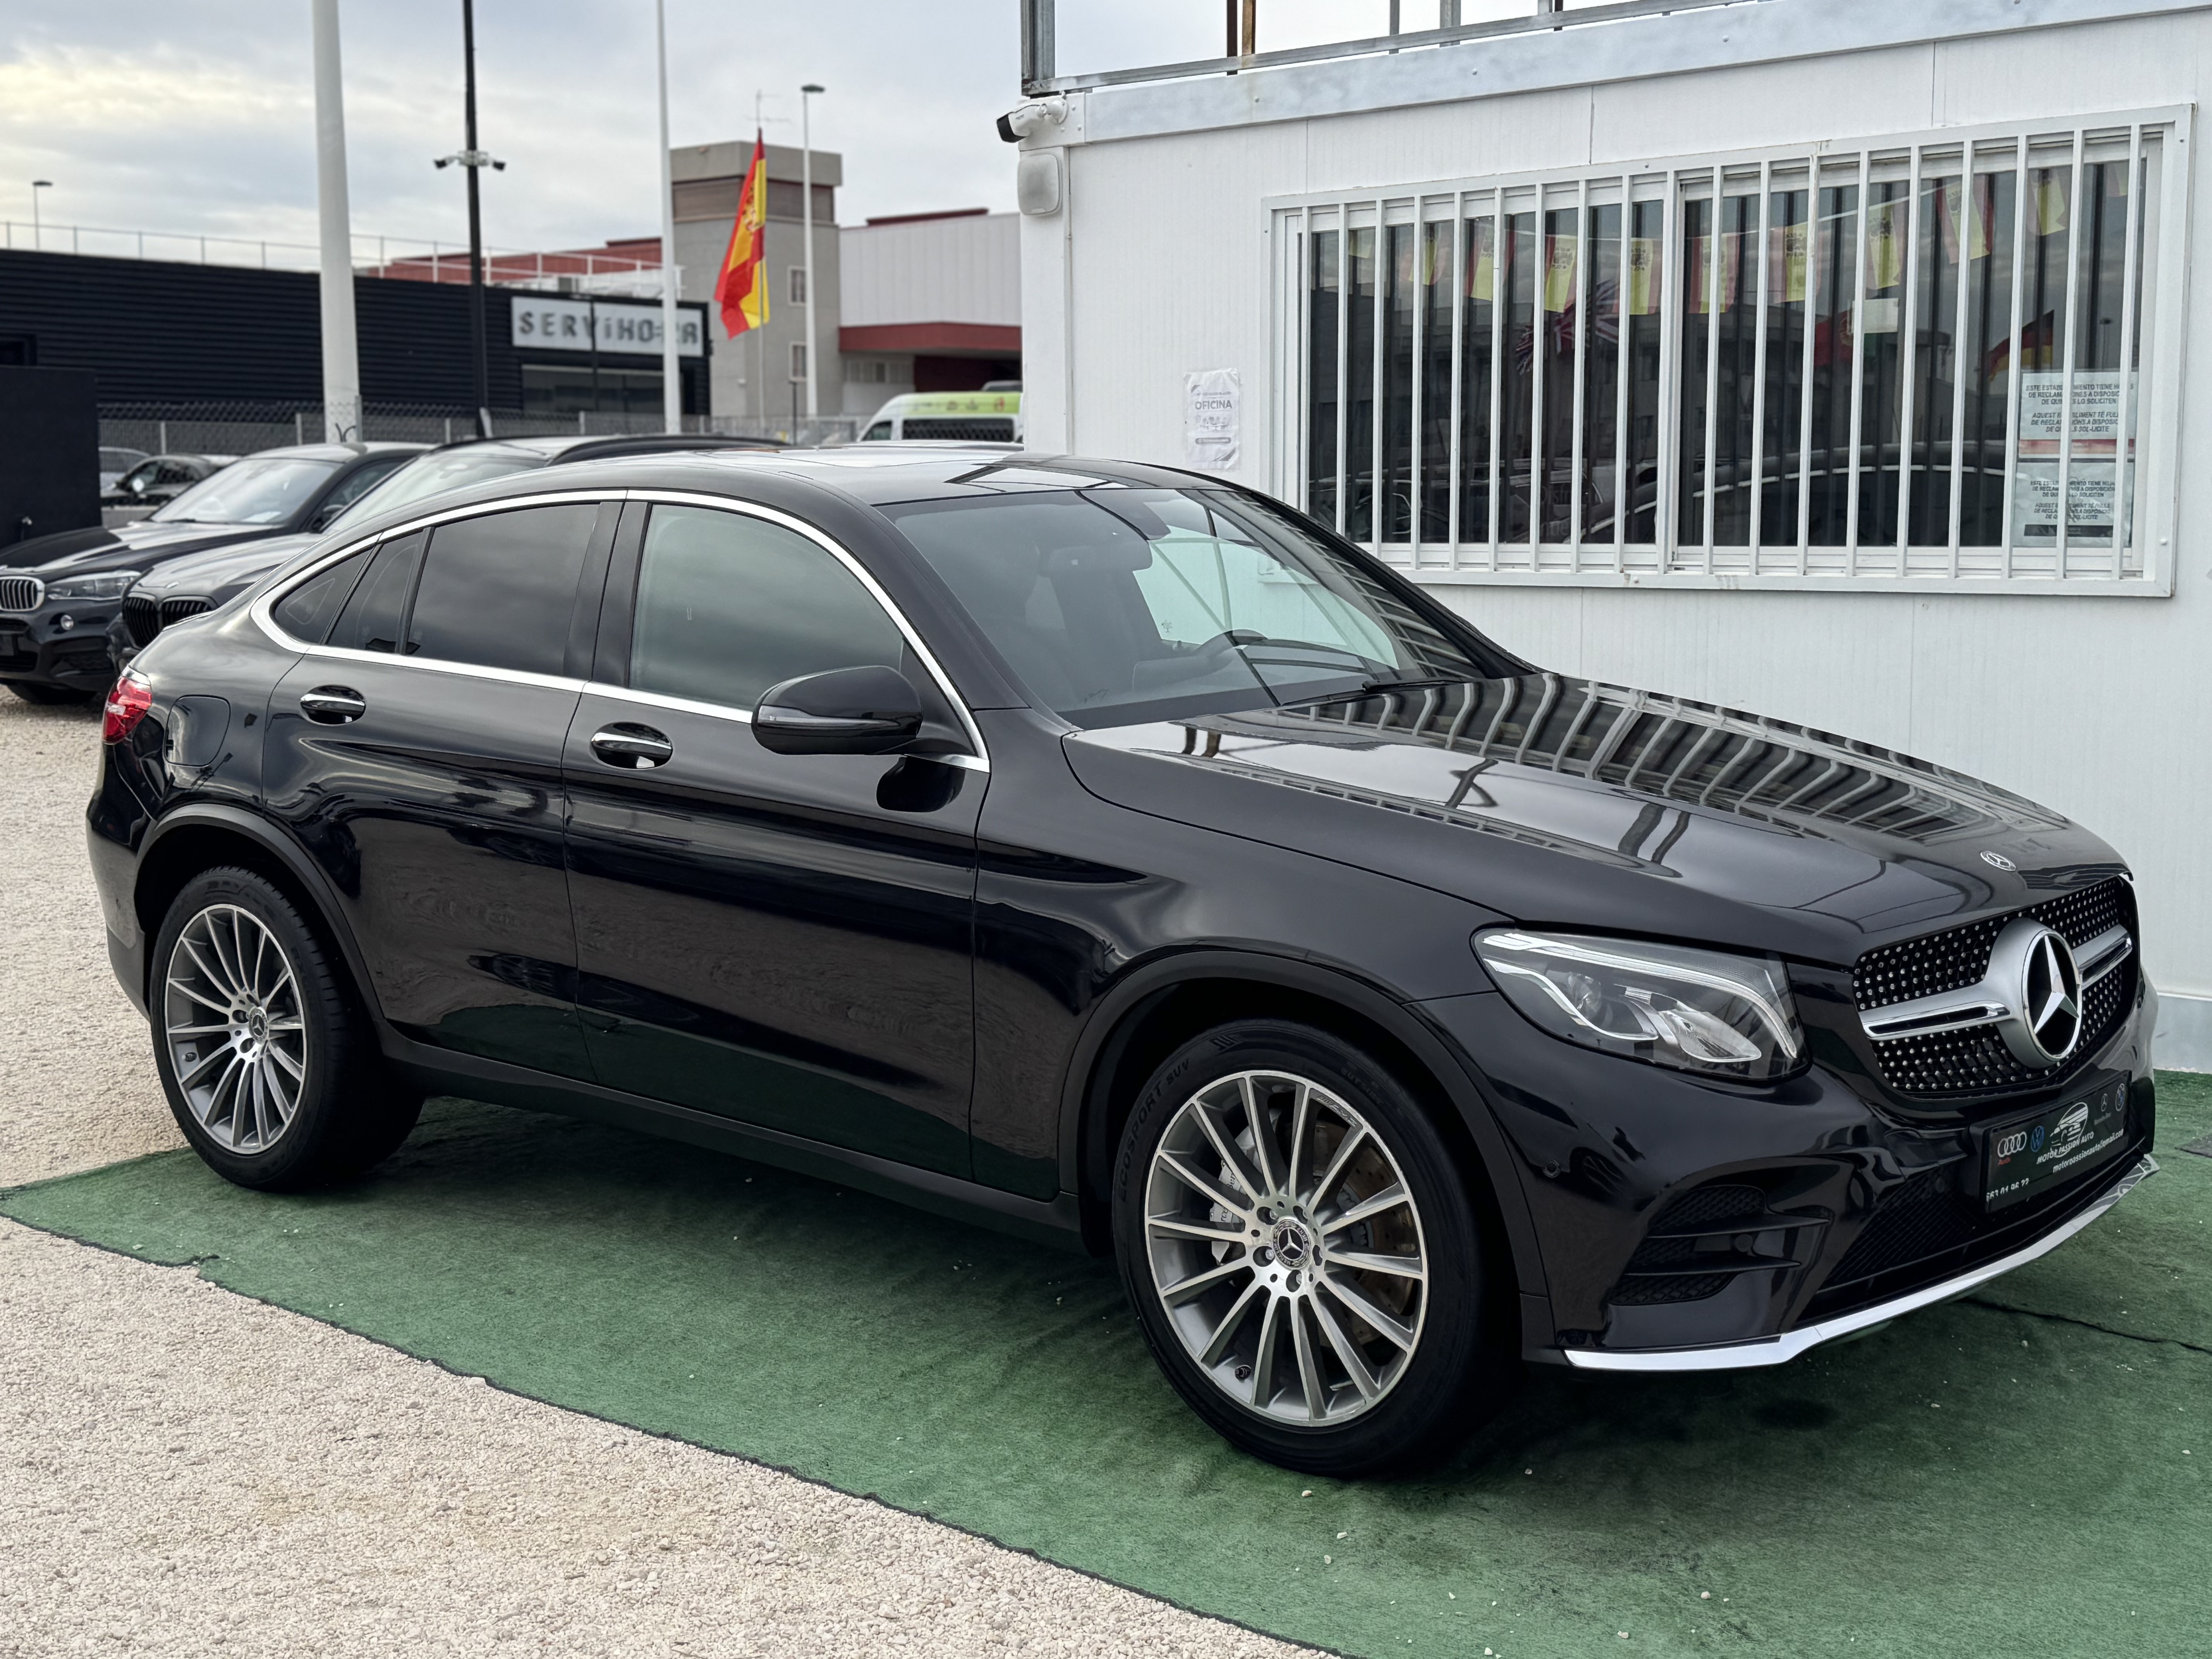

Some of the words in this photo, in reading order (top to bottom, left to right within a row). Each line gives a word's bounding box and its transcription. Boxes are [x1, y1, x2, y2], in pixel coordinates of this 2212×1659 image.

[1195, 400, 1232, 410] OFICINA
[1167, 1058, 1189, 1085] SUV
[2081, 1131, 2094, 1144] AUTO
